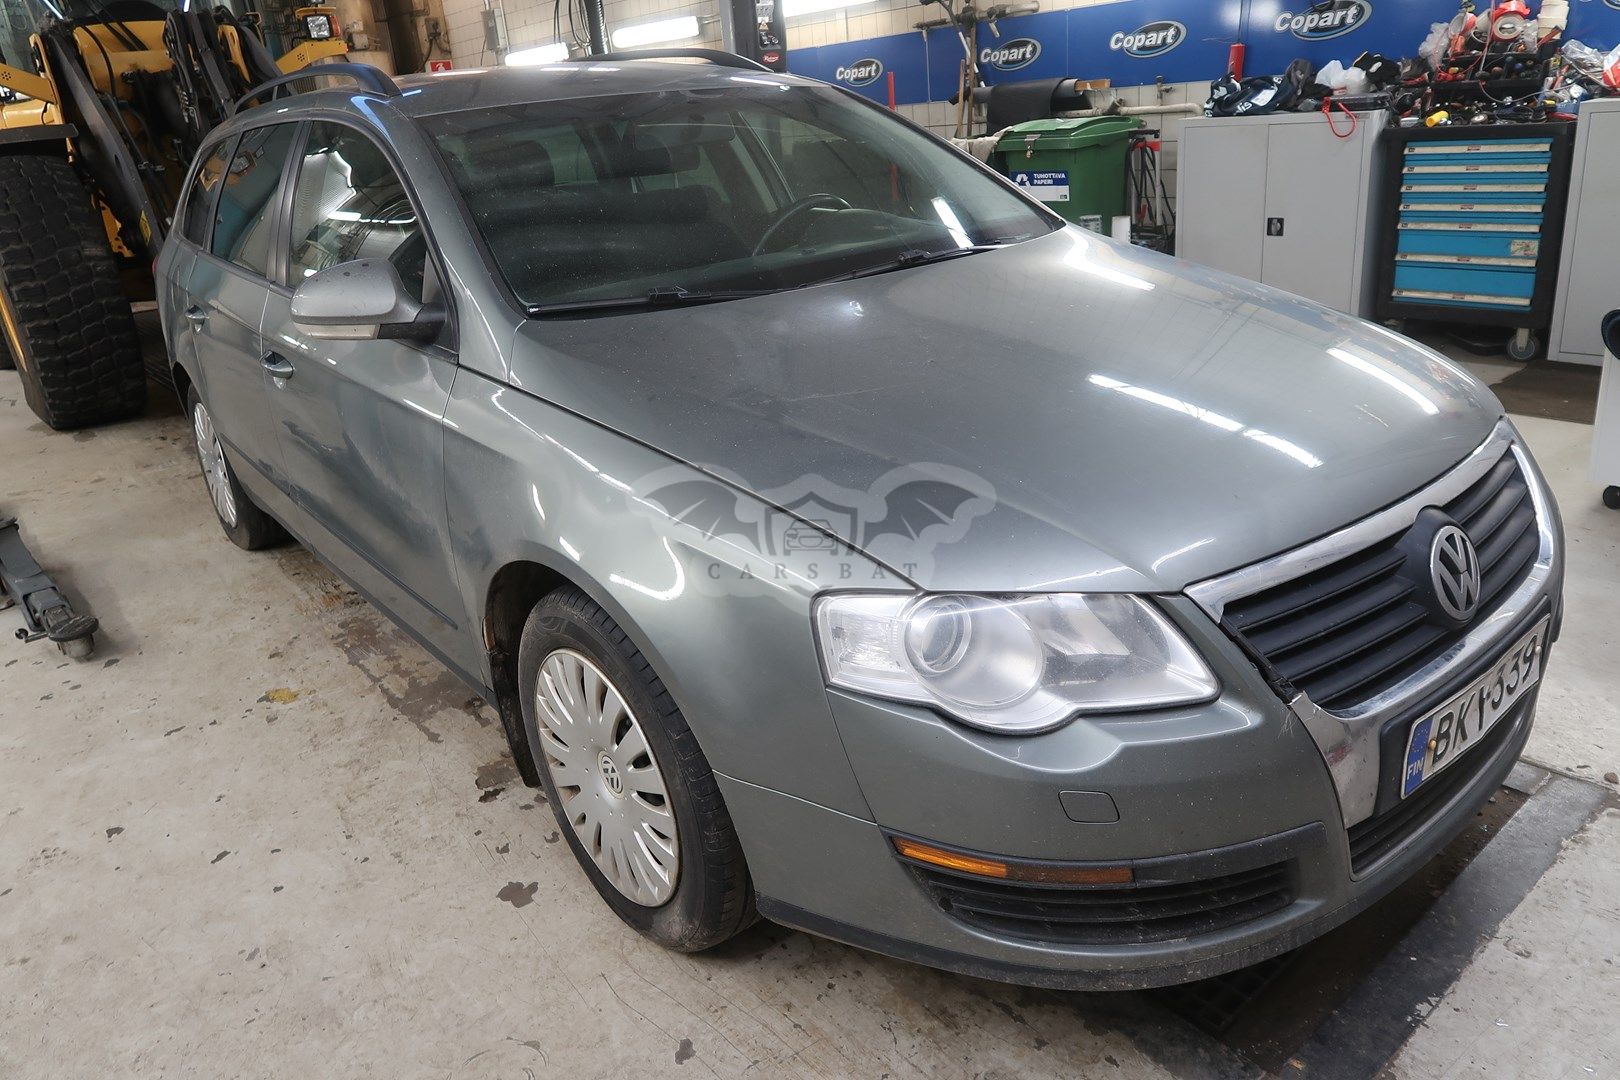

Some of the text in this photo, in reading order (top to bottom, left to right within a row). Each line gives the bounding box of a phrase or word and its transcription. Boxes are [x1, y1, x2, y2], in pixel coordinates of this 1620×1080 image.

[1274, 5, 1358, 33] Copart
[1109, 26, 1176, 51] Copart
[980, 44, 1033, 65] Copart
[836, 63, 877, 81] Copart
[1407, 757, 1424, 780] FIN
